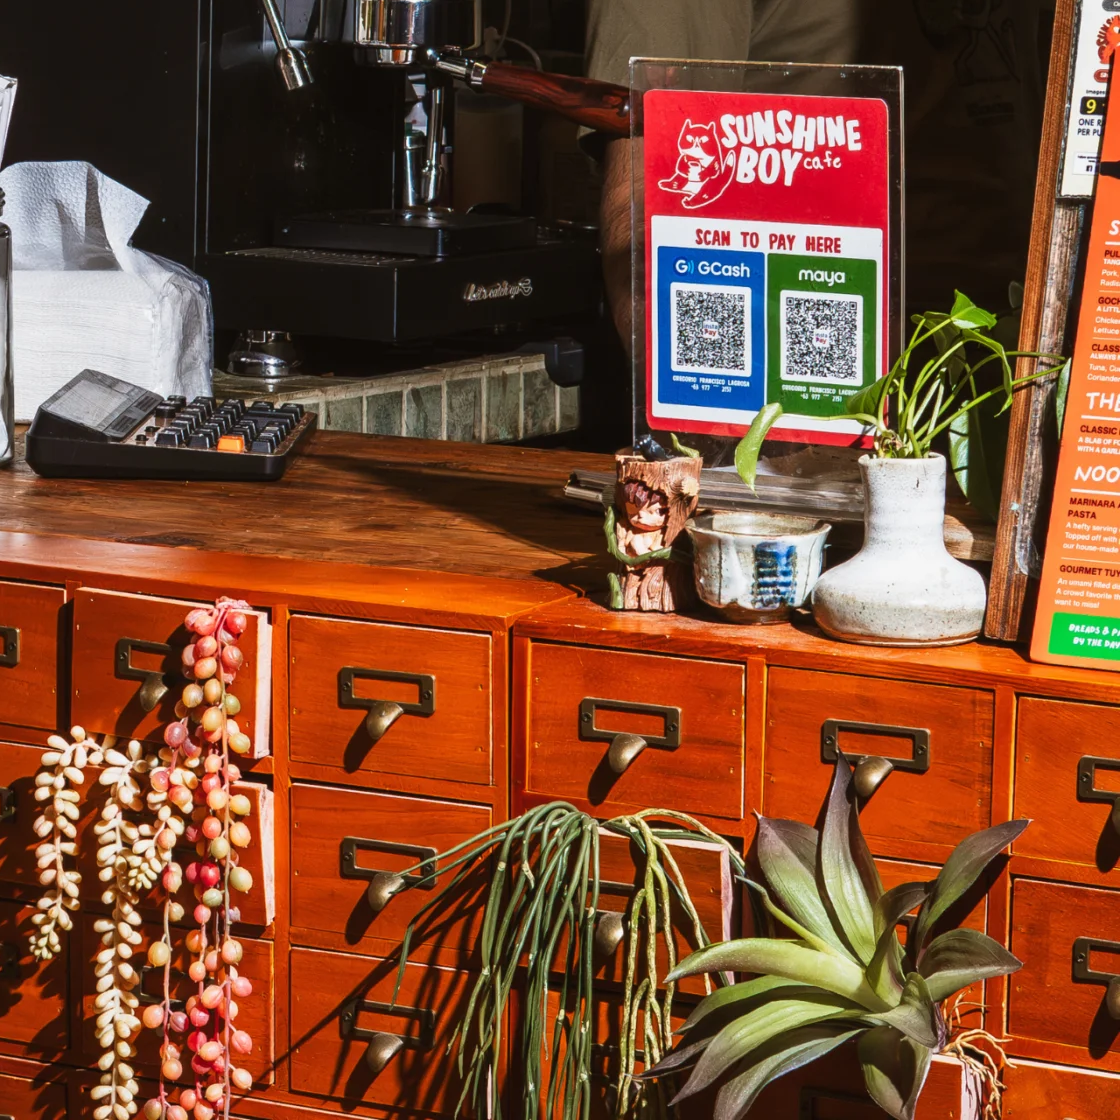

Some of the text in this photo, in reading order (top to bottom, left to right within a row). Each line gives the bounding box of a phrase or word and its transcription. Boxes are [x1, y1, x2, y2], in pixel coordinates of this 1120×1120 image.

[1086, 99, 1097, 114] 9
[1078, 118, 1094, 127] ONE
[720, 110, 862, 152] SUNSHINE
[1077, 128, 1090, 136] PER
[736, 147, 842, 187] BOY cafe
[695, 229, 842, 254] SCAN TO PAY HERE
[697, 260, 751, 278] GCash
[798, 268, 846, 286] maya
[1080, 425, 1117, 435] CLASSIC
[1084, 437, 1102, 445] SLAB
[1069, 497, 1115, 508] MARINARA
[1067, 509, 1097, 519] PASTA
[1073, 522, 1091, 531] hefty
[1092, 525, 1118, 534] serving
[1065, 532, 1090, 541] Topped
[1076, 542, 1119, 553] house-made
[1059, 564, 1103, 576] GOURMET
[1057, 577, 1067, 585] An
[1063, 589, 1085, 597] crowd
[1086, 590, 1112, 600] favorite
[1081, 601, 1100, 609] miss!
[1068, 623, 1109, 635] BREADS &
[1073, 637, 1085, 645] BY
[1087, 638, 1102, 646] THE
